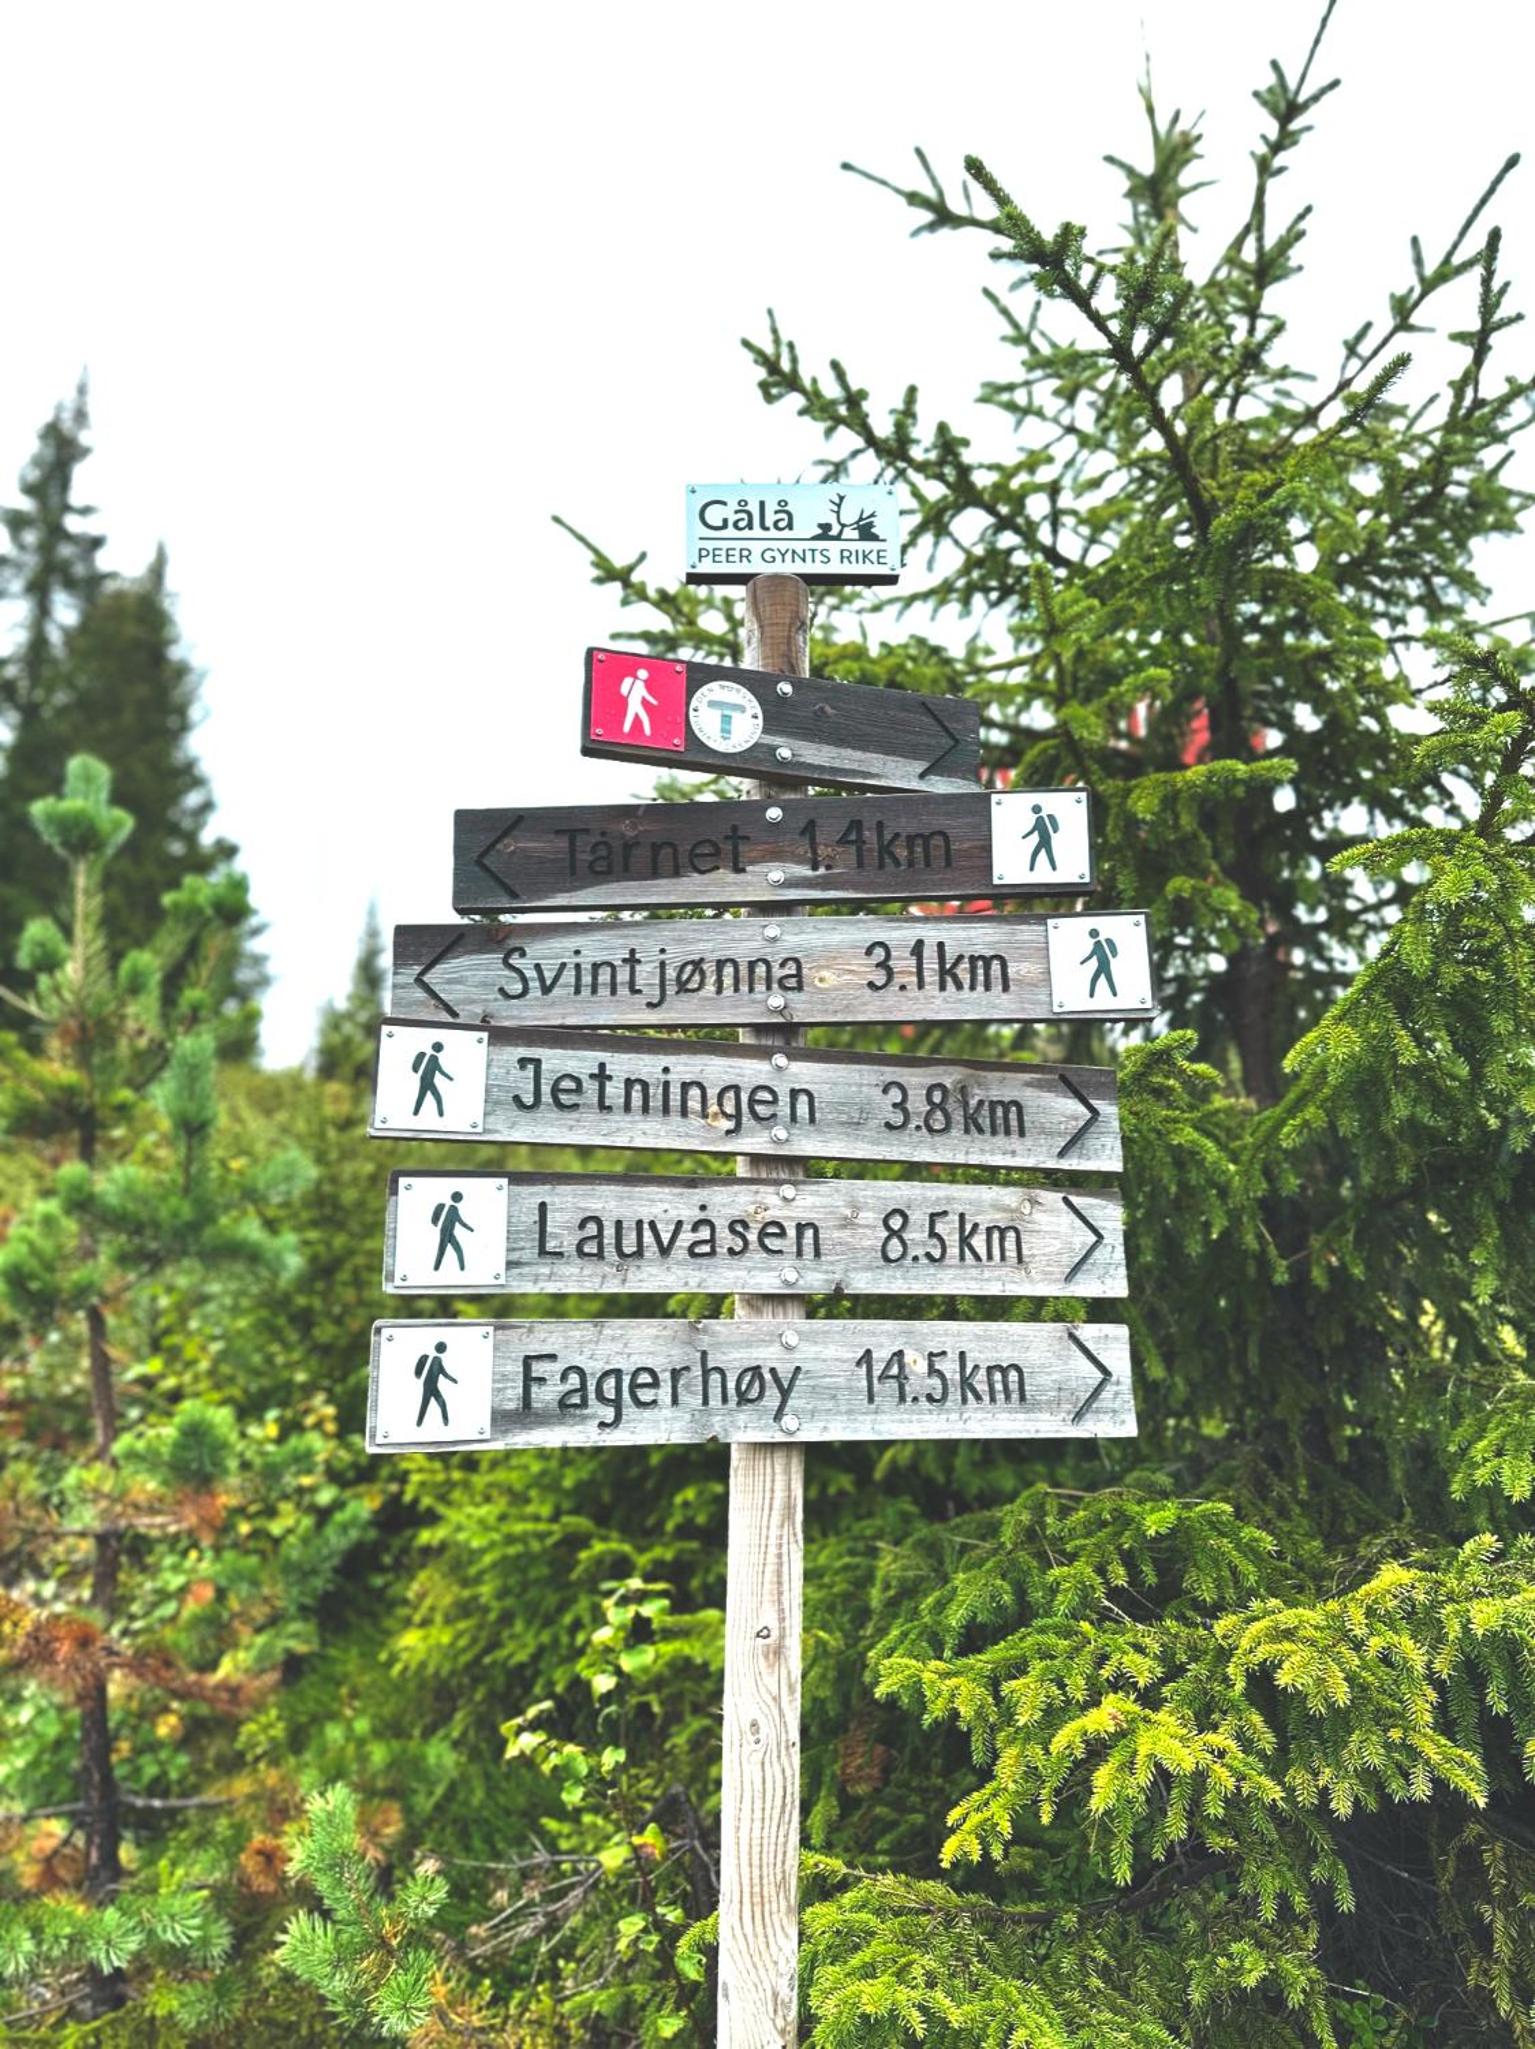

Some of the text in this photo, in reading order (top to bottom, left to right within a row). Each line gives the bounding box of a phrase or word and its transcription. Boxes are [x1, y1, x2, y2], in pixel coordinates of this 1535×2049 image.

[698, 498, 795, 532] Gålå
[698, 547, 889, 566] PEER GYNTS RIKE
[554, 818, 953, 877] Tårnet 1.4km
[498, 939, 1012, 1009] Svintjønna 3.1km
[511, 1056, 1026, 1139] Jetningen 3.8km
[537, 1200, 1026, 1265] Lauvåsen 8.5km
[520, 1347, 1029, 1430] Fagerhøy 14.5km
